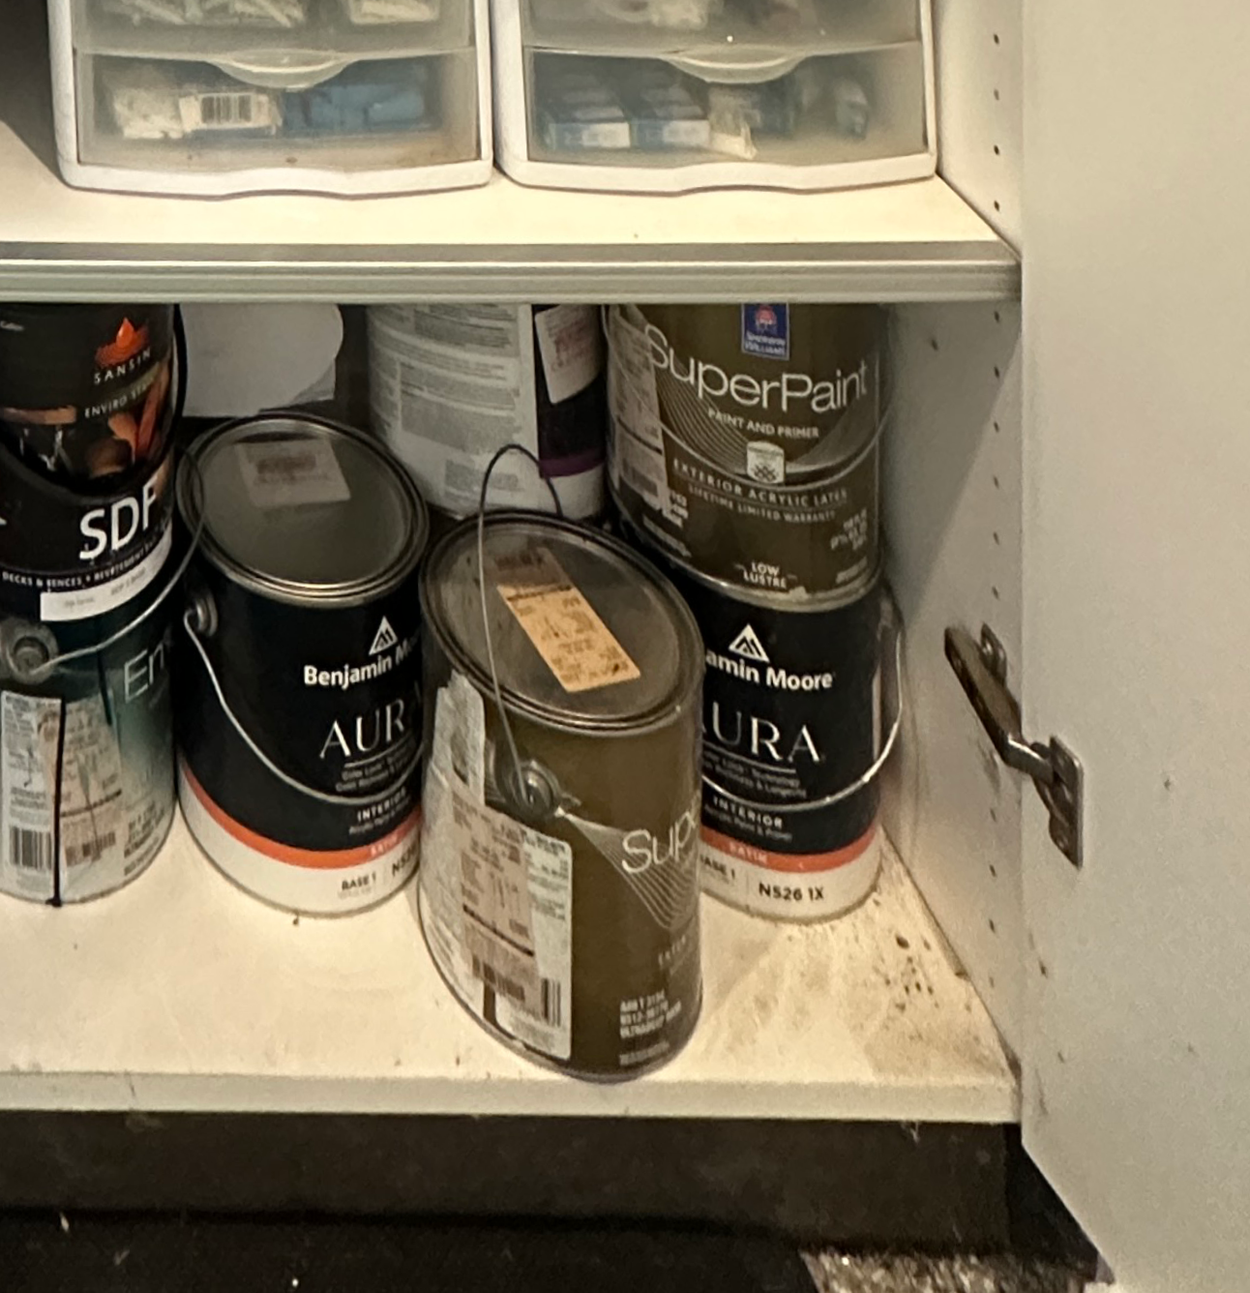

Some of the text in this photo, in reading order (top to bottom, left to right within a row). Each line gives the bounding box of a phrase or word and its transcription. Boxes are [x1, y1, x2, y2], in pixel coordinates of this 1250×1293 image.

[92, 346, 151, 385] SANSIN
[645, 323, 868, 413] SuperPaint
[84, 394, 128, 419] ENVIRO
[706, 407, 820, 439] PAINT AND PRIMER
[673, 457, 743, 496] EXTERIOR
[748, 488, 809, 508] ACRYLIC
[743, 570, 788, 589] LUSTRE
[751, 560, 781, 577] LOW
[303, 653, 393, 690] Benjamin
[705, 648, 834, 692] amin Moore
[319, 698, 407, 760] AUR
[707, 700, 821, 763] URA
[712, 795, 784, 829] INTERIOR
[700, 851, 728, 876] ASE
[341, 875, 370, 891] BASE
[758, 882, 825, 902] N526 1X
